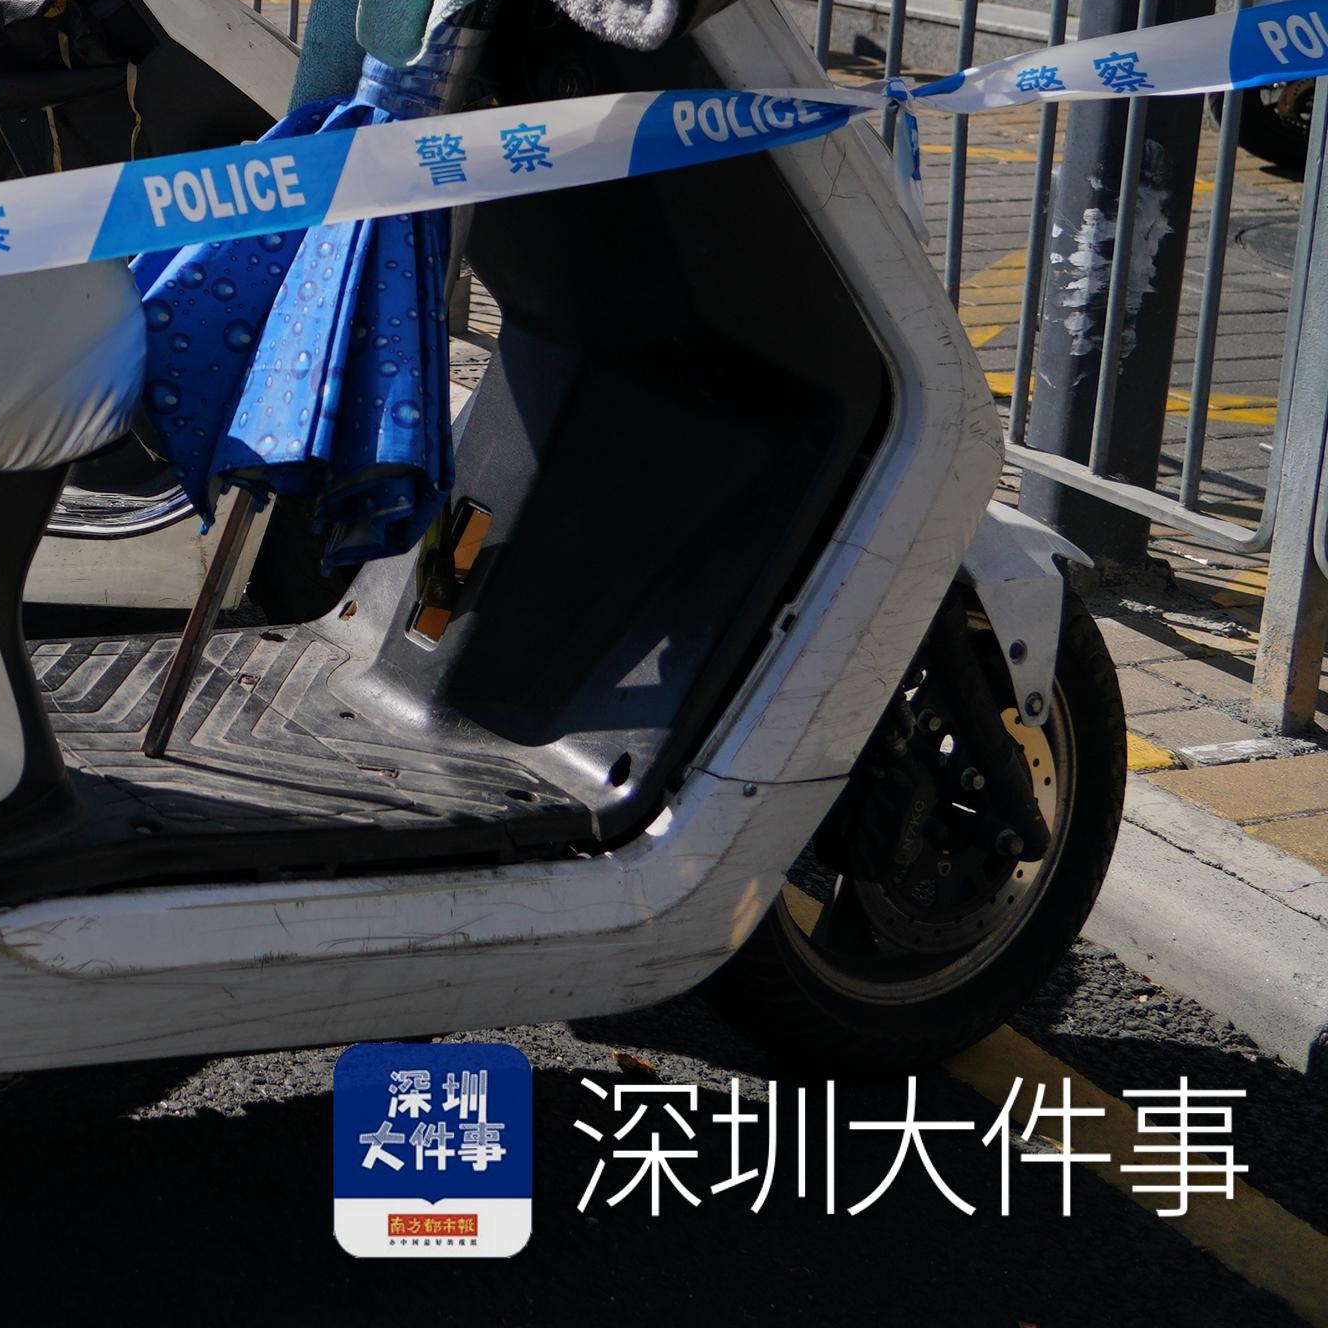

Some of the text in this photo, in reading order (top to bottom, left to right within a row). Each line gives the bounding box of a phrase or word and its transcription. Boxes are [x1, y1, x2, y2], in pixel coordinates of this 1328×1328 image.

[1259, 2, 1328, 60] POL
[414, 120, 553, 187] 警察
[144, 153, 307, 228] POLICE
